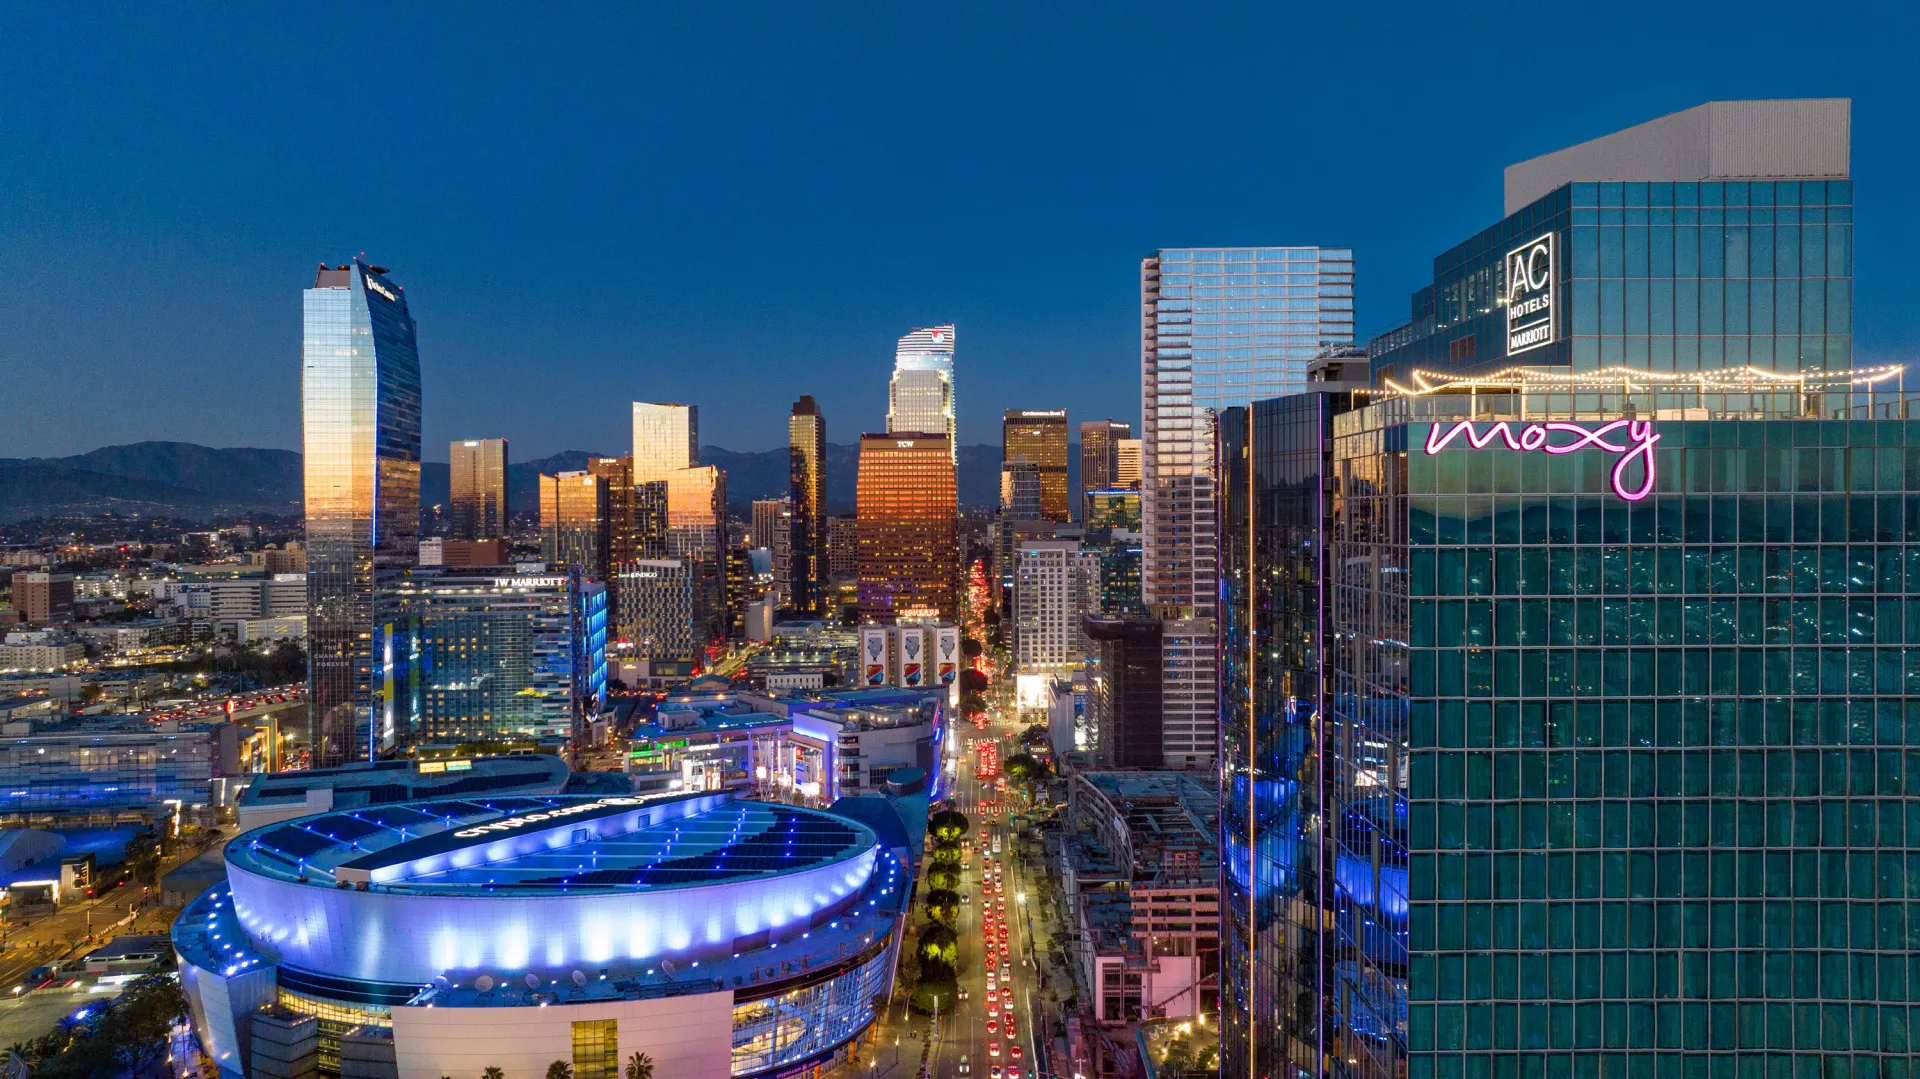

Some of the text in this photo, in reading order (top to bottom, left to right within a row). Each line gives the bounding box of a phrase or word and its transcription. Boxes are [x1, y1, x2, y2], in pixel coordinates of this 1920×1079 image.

[1511, 244, 1548, 299] AC
[1510, 294, 1549, 320] HOTELS
[1510, 325, 1549, 349] MARRIOTT
[897, 440, 914, 448] TCW
[1425, 420, 1661, 500] moxy
[494, 577, 564, 587] JW MARRIOTT
